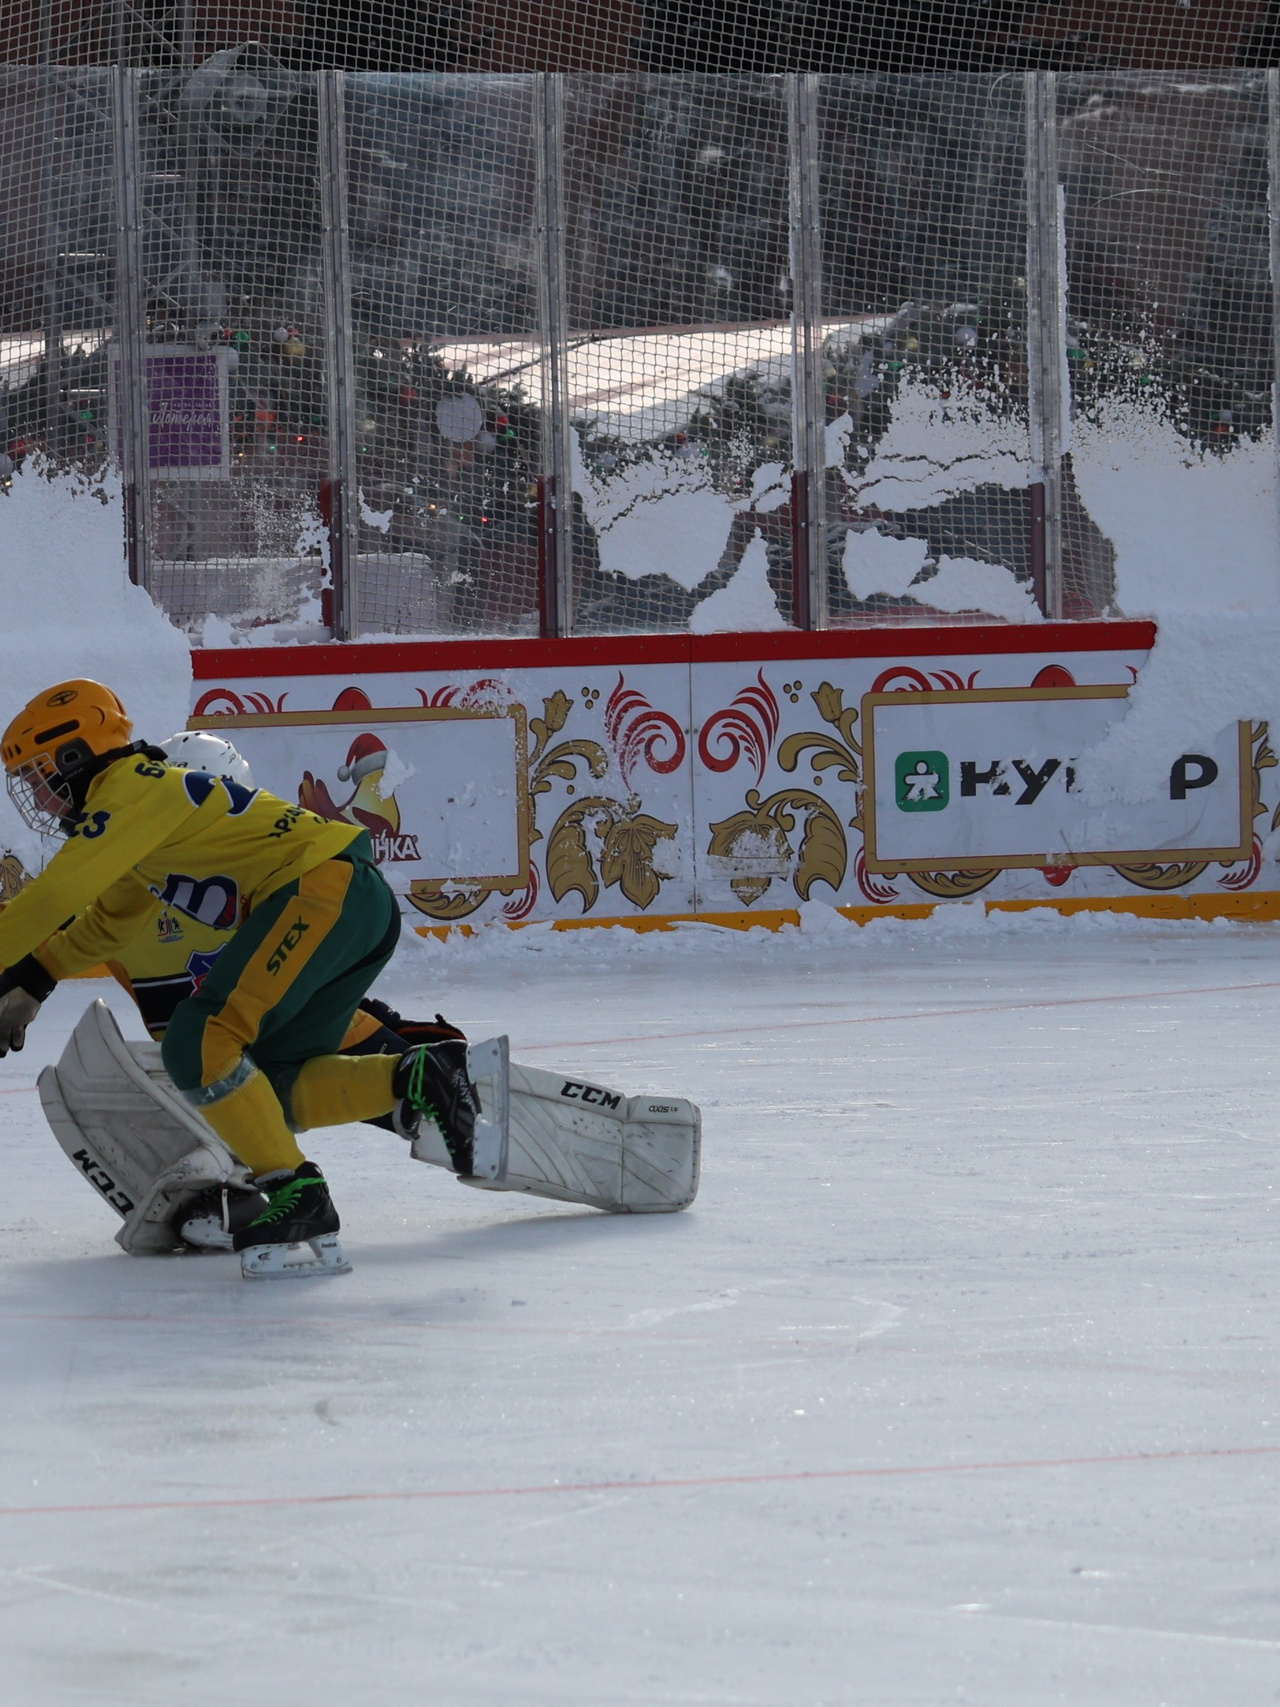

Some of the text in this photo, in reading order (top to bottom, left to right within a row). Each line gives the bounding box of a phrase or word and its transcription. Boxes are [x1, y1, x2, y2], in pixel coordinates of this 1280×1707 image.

[266, 915, 310, 976] STEX
[560, 1081, 621, 1110] CCM
[72, 1148, 135, 1216] CCM
